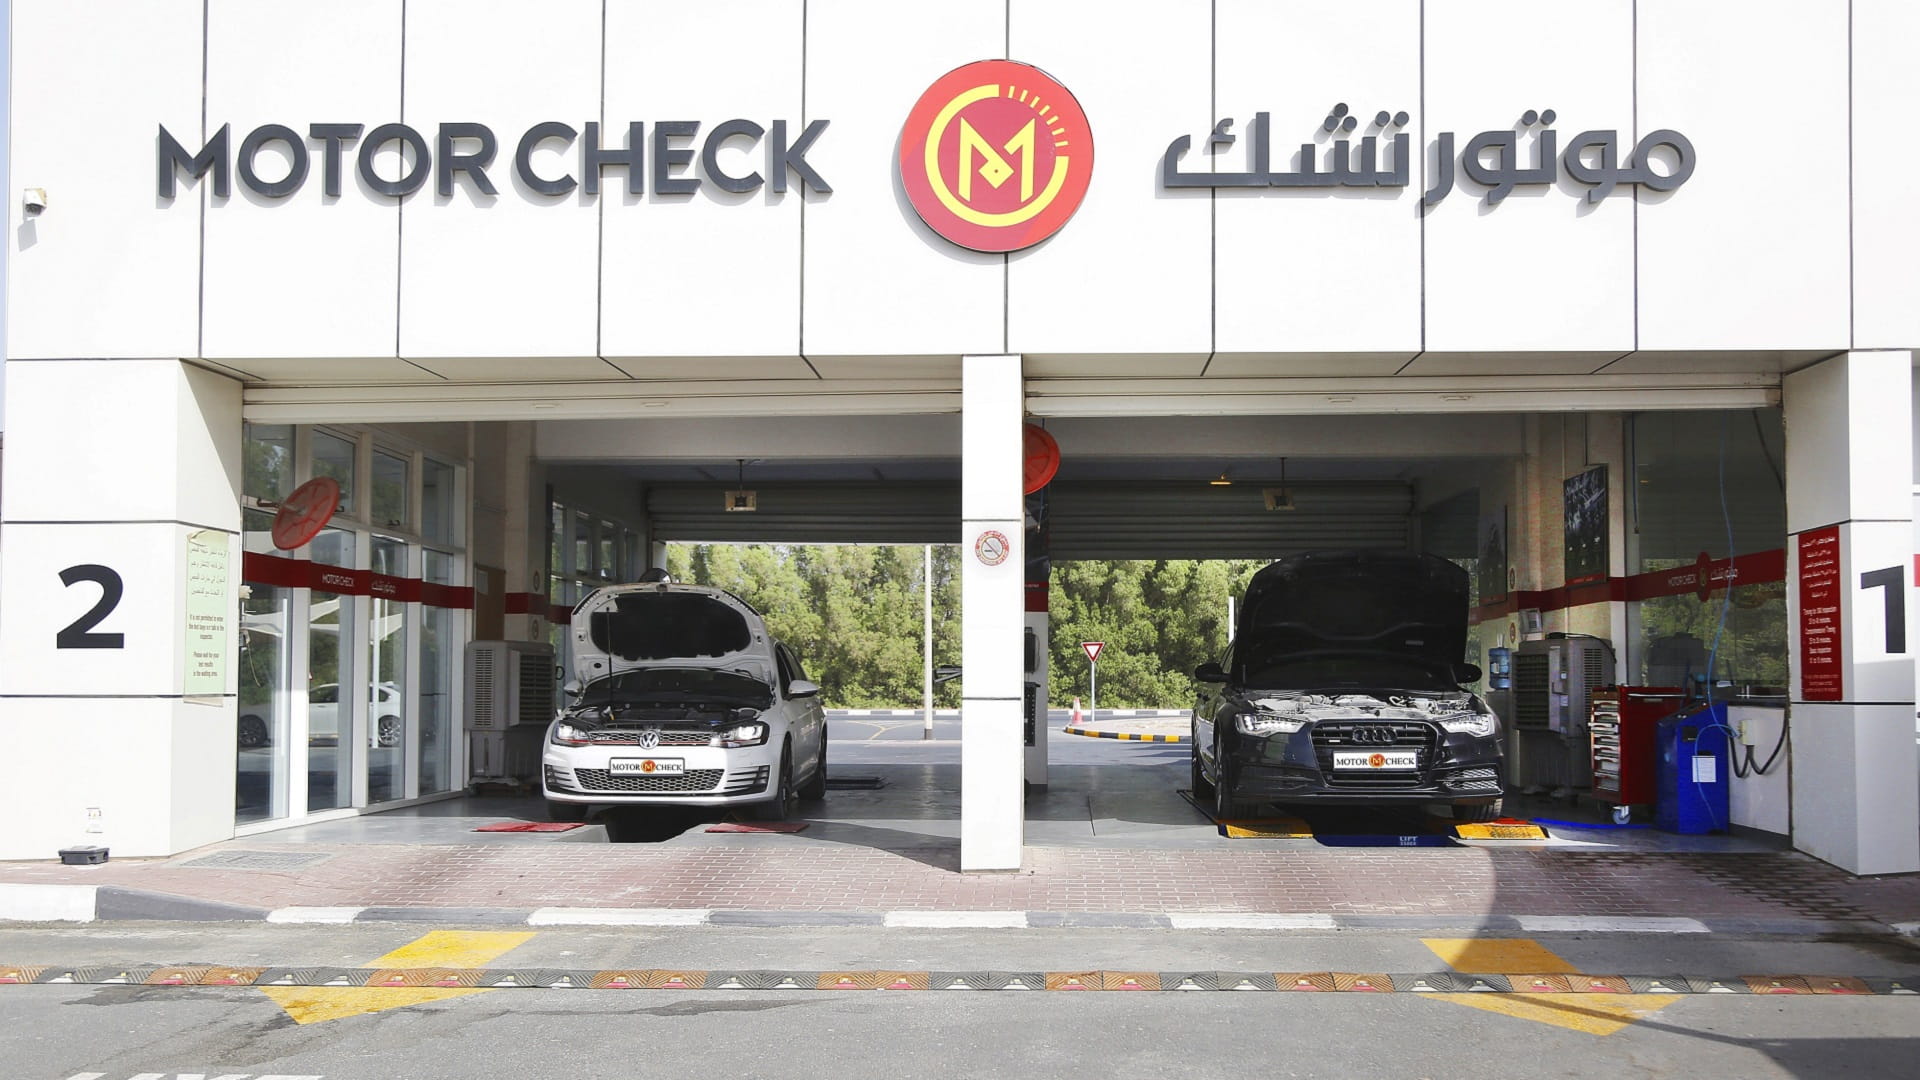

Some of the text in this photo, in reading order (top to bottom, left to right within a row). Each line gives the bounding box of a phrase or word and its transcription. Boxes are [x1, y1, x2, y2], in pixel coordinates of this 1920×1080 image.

[158, 118, 833, 198] MOTOR CHECK
[1163, 102, 1696, 207] موتور تشك
[56, 563, 125, 649] 2
[1860, 565, 1907, 654] 1
[656, 763, 682, 771] CHECK
[1336, 758, 1368, 766] MOTOR
[1385, 757, 1415, 765] CHECK
